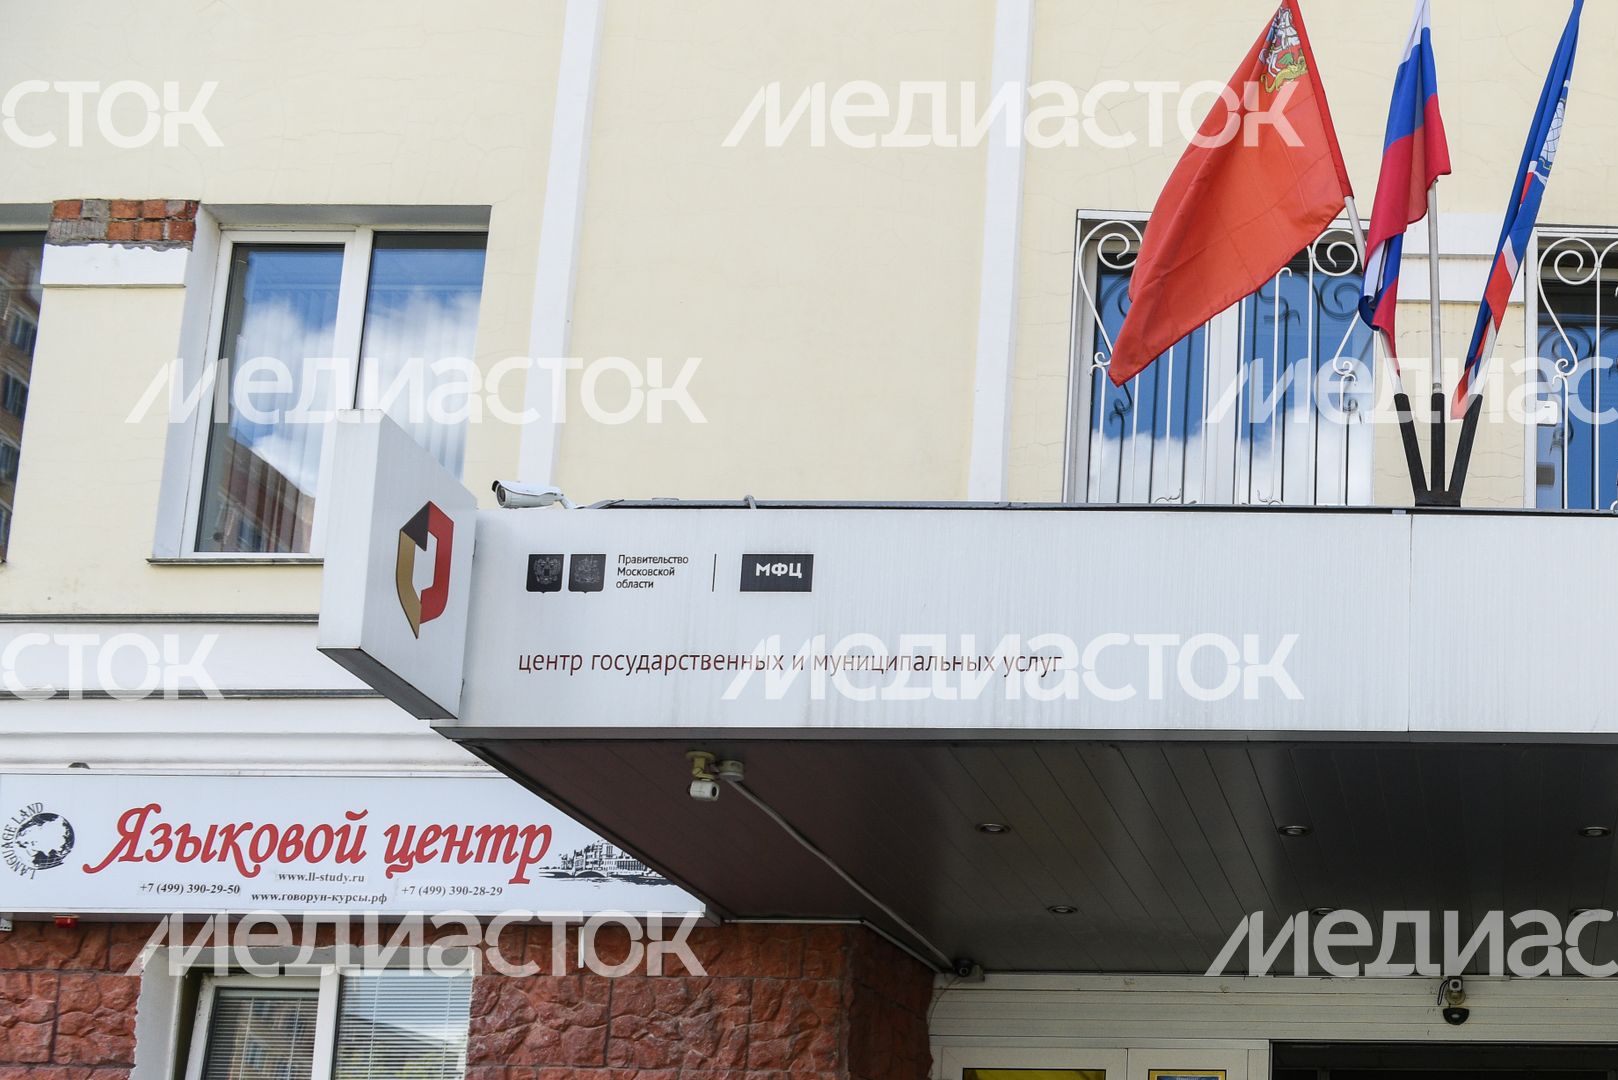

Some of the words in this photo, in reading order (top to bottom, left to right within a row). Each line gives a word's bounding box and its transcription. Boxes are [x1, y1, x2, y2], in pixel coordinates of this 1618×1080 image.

[617, 555, 689, 566] Правительство
[617, 567, 675, 577] Московской
[755, 562, 802, 579] МФЦ
[616, 579, 654, 589] области
[518, 654, 583, 676] центр
[591, 654, 784, 676] государственных
[791, 655, 804, 671] и
[813, 655, 996, 676] муниципальных
[1003, 655, 1062, 678] услуг
[83, 803, 367, 878] Языковой
[383, 816, 553, 884] центр
[140, 883, 154, 893] +7
[156, 883, 184, 895] (499)
[186, 883, 241, 895] 390-29-50
[401, 886, 416, 896] +7
[418, 885, 446, 897] (499)
[449, 885, 503, 897] 390-28-29
